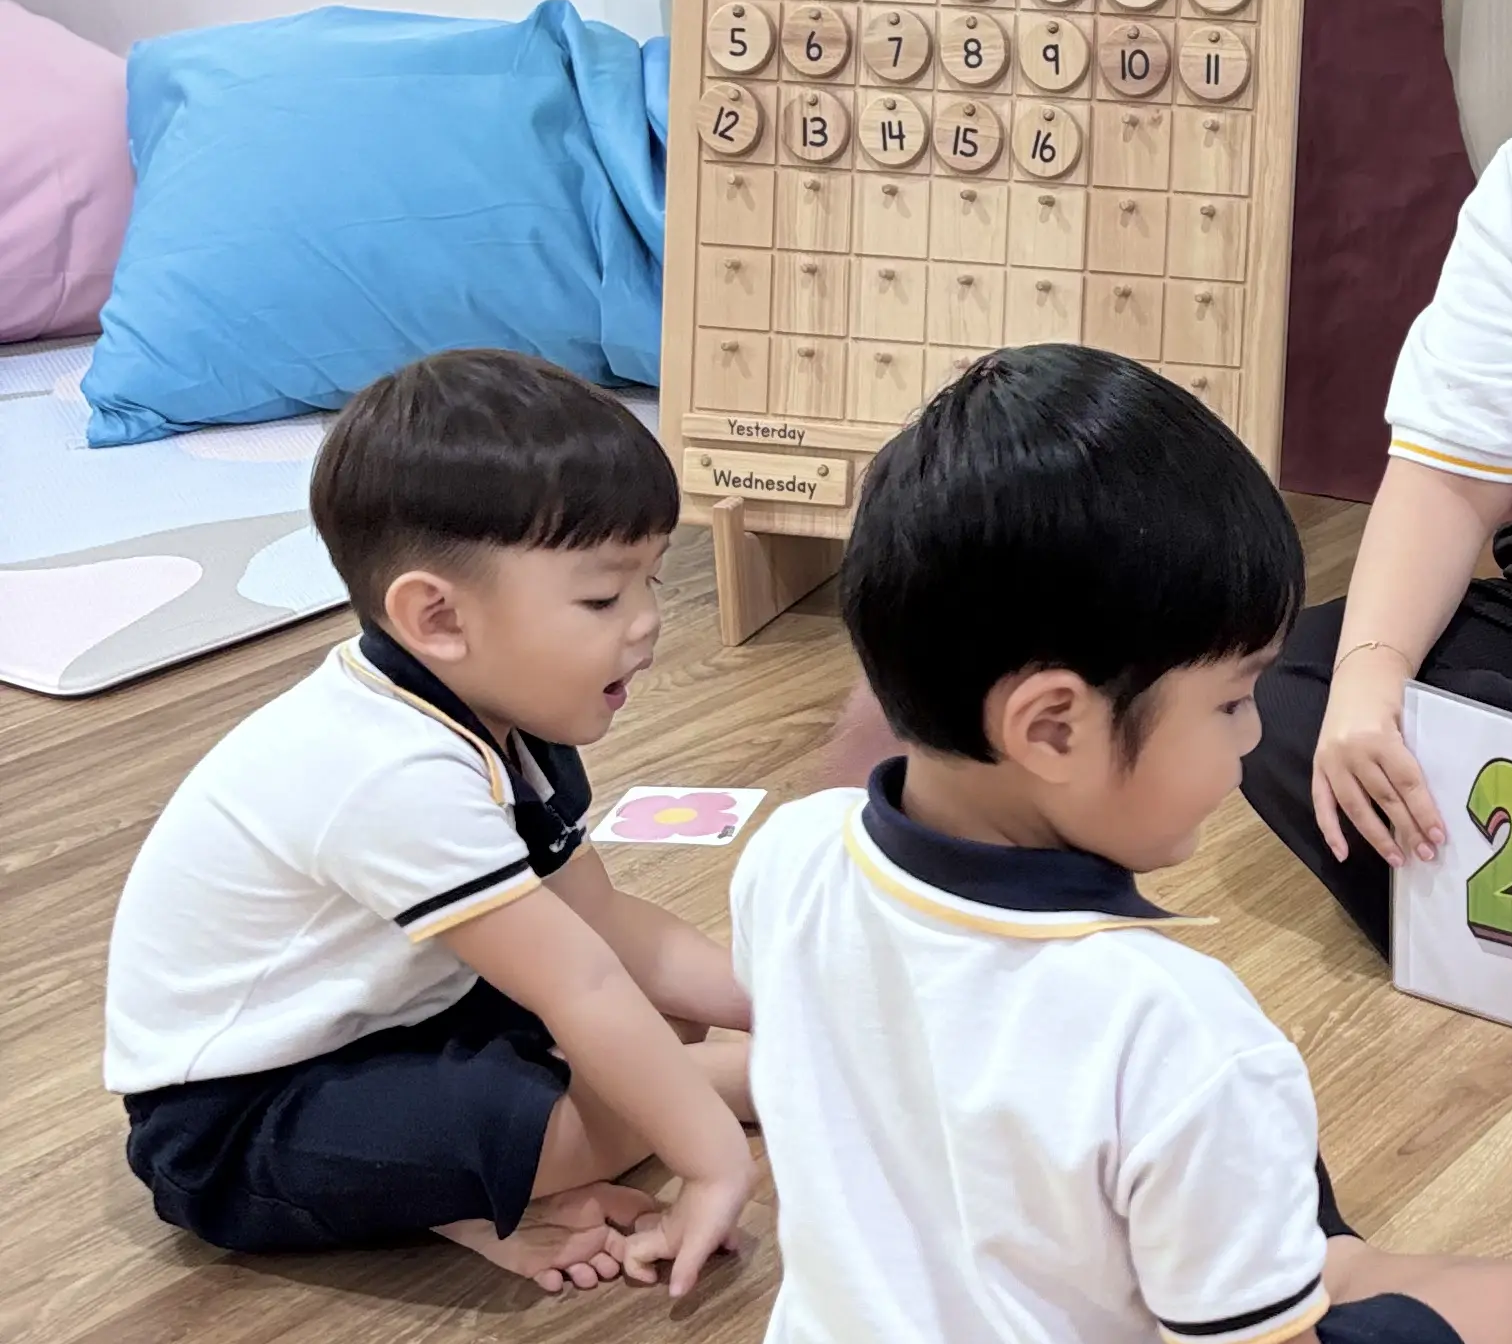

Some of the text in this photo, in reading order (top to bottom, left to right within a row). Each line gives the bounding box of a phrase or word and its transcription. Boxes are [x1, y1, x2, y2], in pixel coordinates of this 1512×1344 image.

[728, 27, 1220, 86] 5 6 7 8 9 10 11
[712, 106, 1057, 164] 12 13 14 15 16
[727, 418, 806, 446] Yesterday
[712, 467, 818, 501] Wednesday
